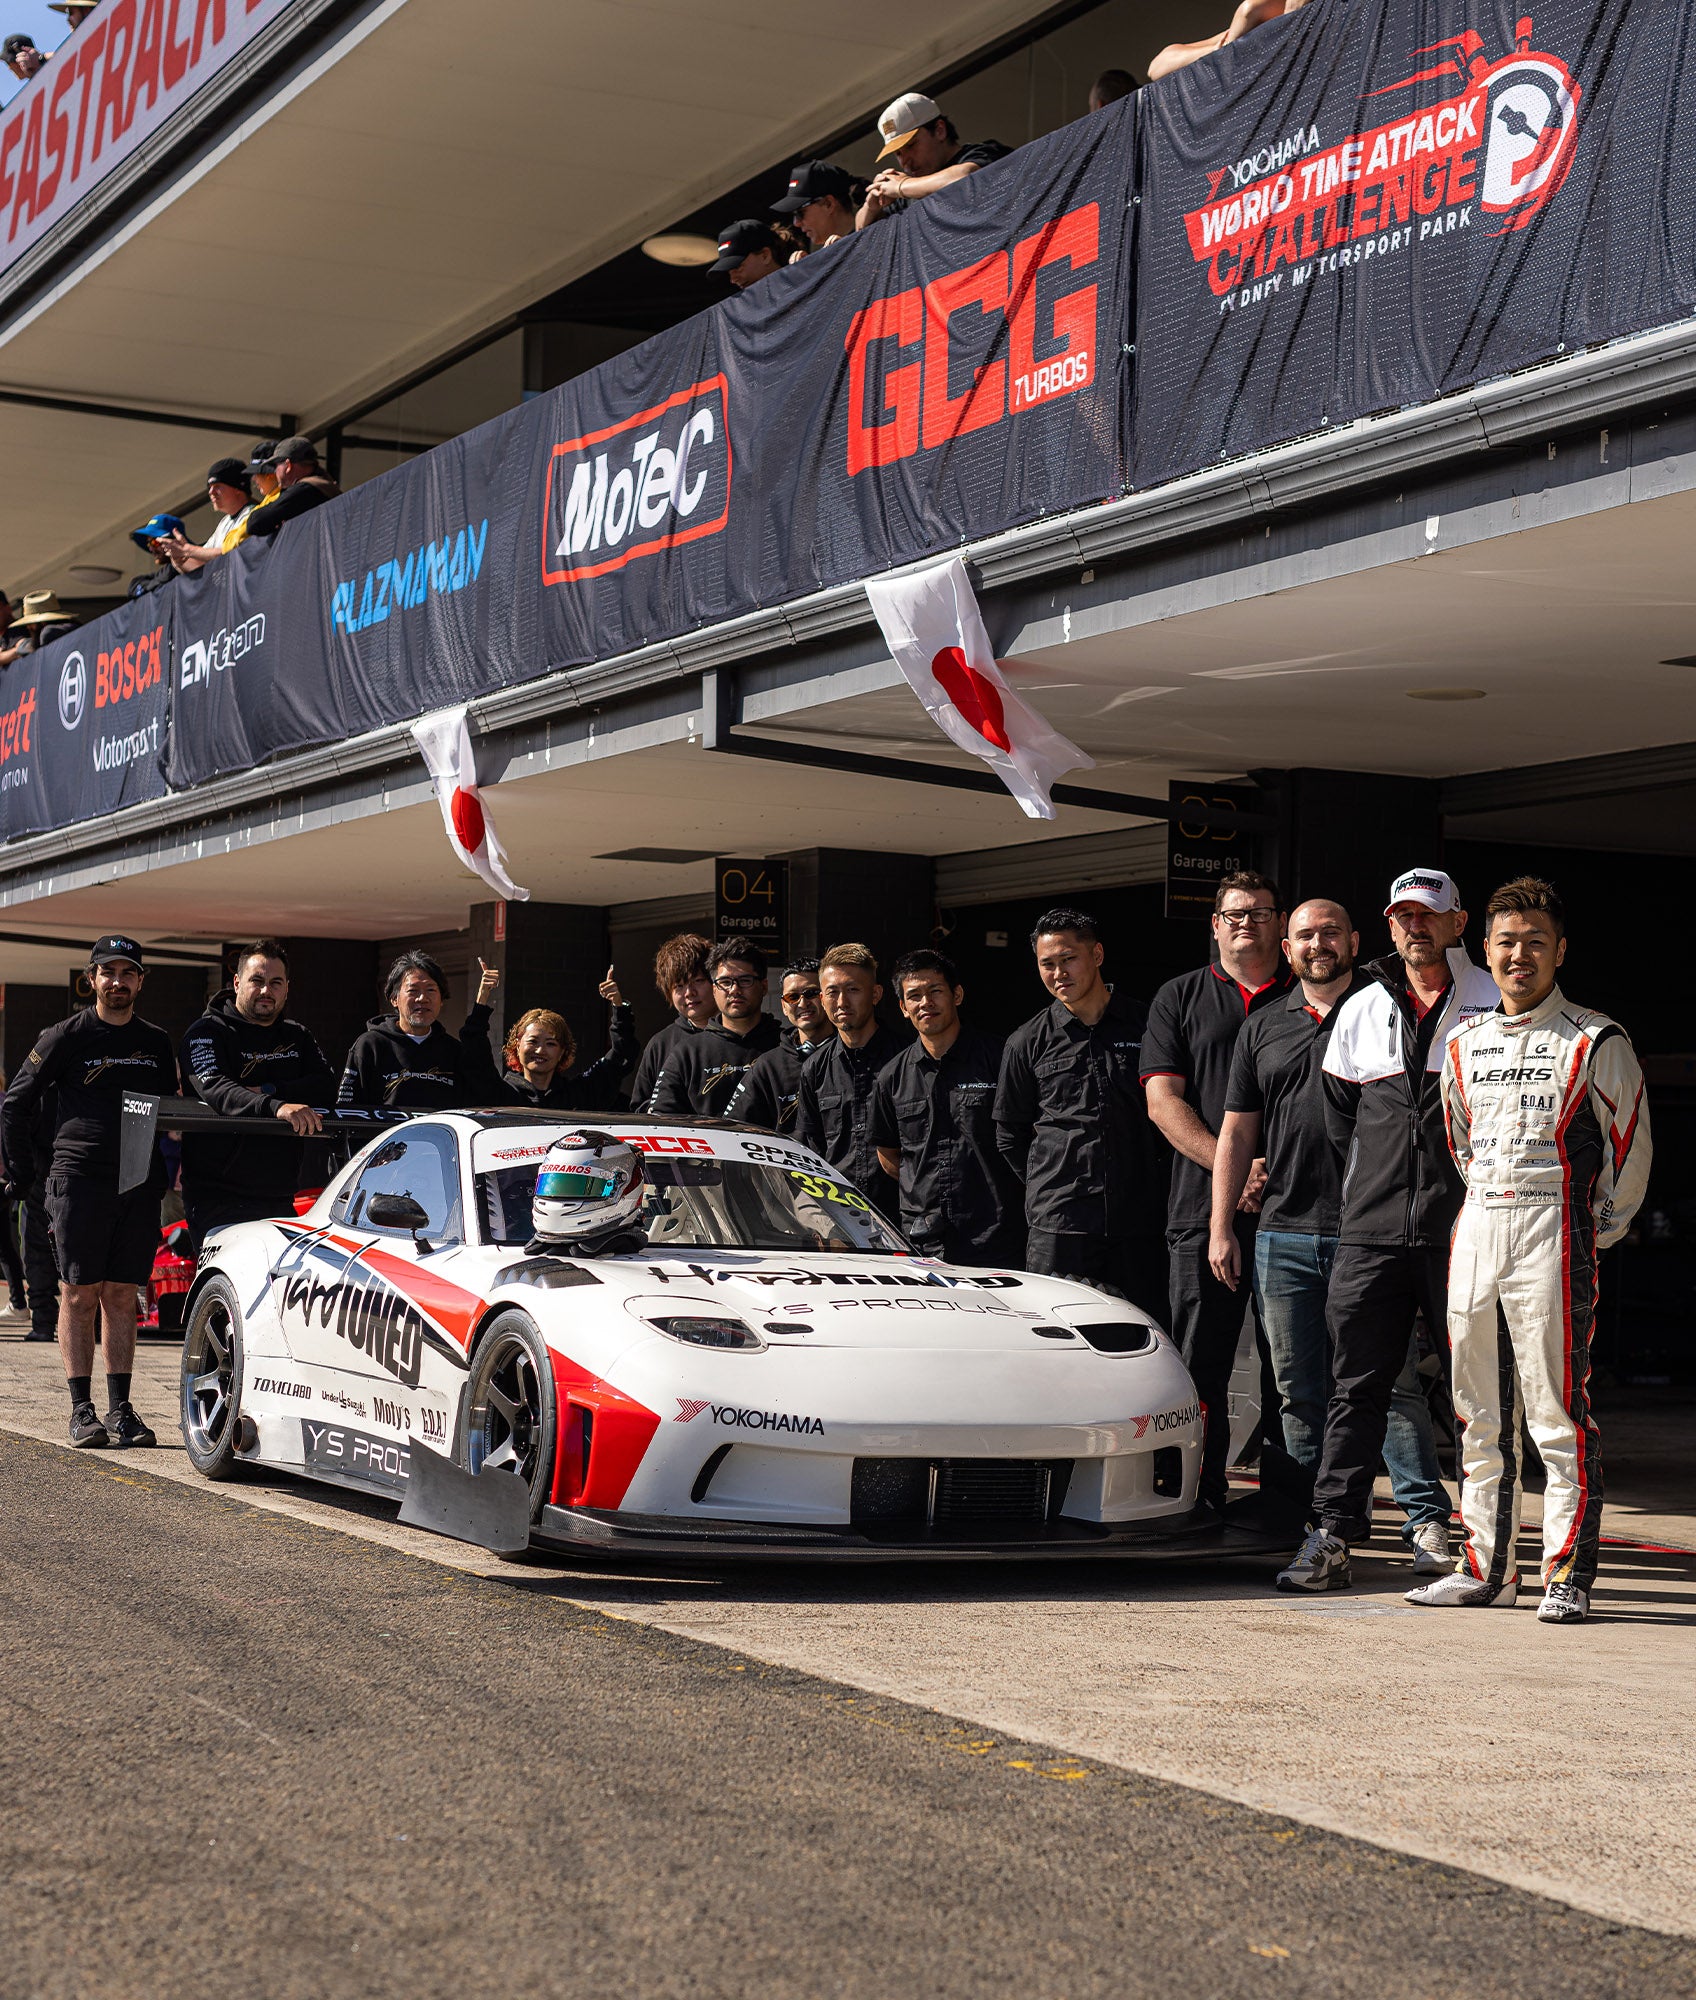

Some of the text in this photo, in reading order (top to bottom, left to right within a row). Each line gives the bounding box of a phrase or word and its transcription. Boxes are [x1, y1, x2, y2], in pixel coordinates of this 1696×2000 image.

[1301, 141, 1364, 202] TIME
[1366, 96, 1480, 176] ATTACK
[1207, 149, 1477, 296] CHALLENGE
[1420, 206, 1472, 241] PARK
[844, 201, 1100, 477] GCG
[1014, 352, 1089, 406] TURBOS
[556, 408, 715, 557] MoTeC
[95, 626, 163, 708] BOSCH
[93, 716, 158, 772] Motorsport
[1173, 852, 1240, 873] Garage 03
[722, 869, 775, 904] 04
[720, 915, 777, 930] Garage 04
[110, 939, 133, 951] brap
[84, 1058, 102, 1066] YS
[1472, 1068, 1553, 1084] LEARS
[382, 1071, 454, 1087] YS PRODUCE
[128, 1101, 153, 1116] SCOOT
[1520, 1094, 1556, 1110] G.O.A.T
[614, 1135, 824, 1169] GCG OPEN
[747, 1151, 832, 1177] CLASS
[541, 1164, 592, 1175] TERRAMOS
[790, 1171, 871, 1212] 320
[752, 1299, 1046, 1321] YS PRODUCE
[254, 1376, 312, 1400] TOXICLABO
[373, 1397, 411, 1431] Moty's
[711, 1403, 1200, 1436] YOKOHAMA YOKOHAMA
[308, 1425, 345, 1457] YS
